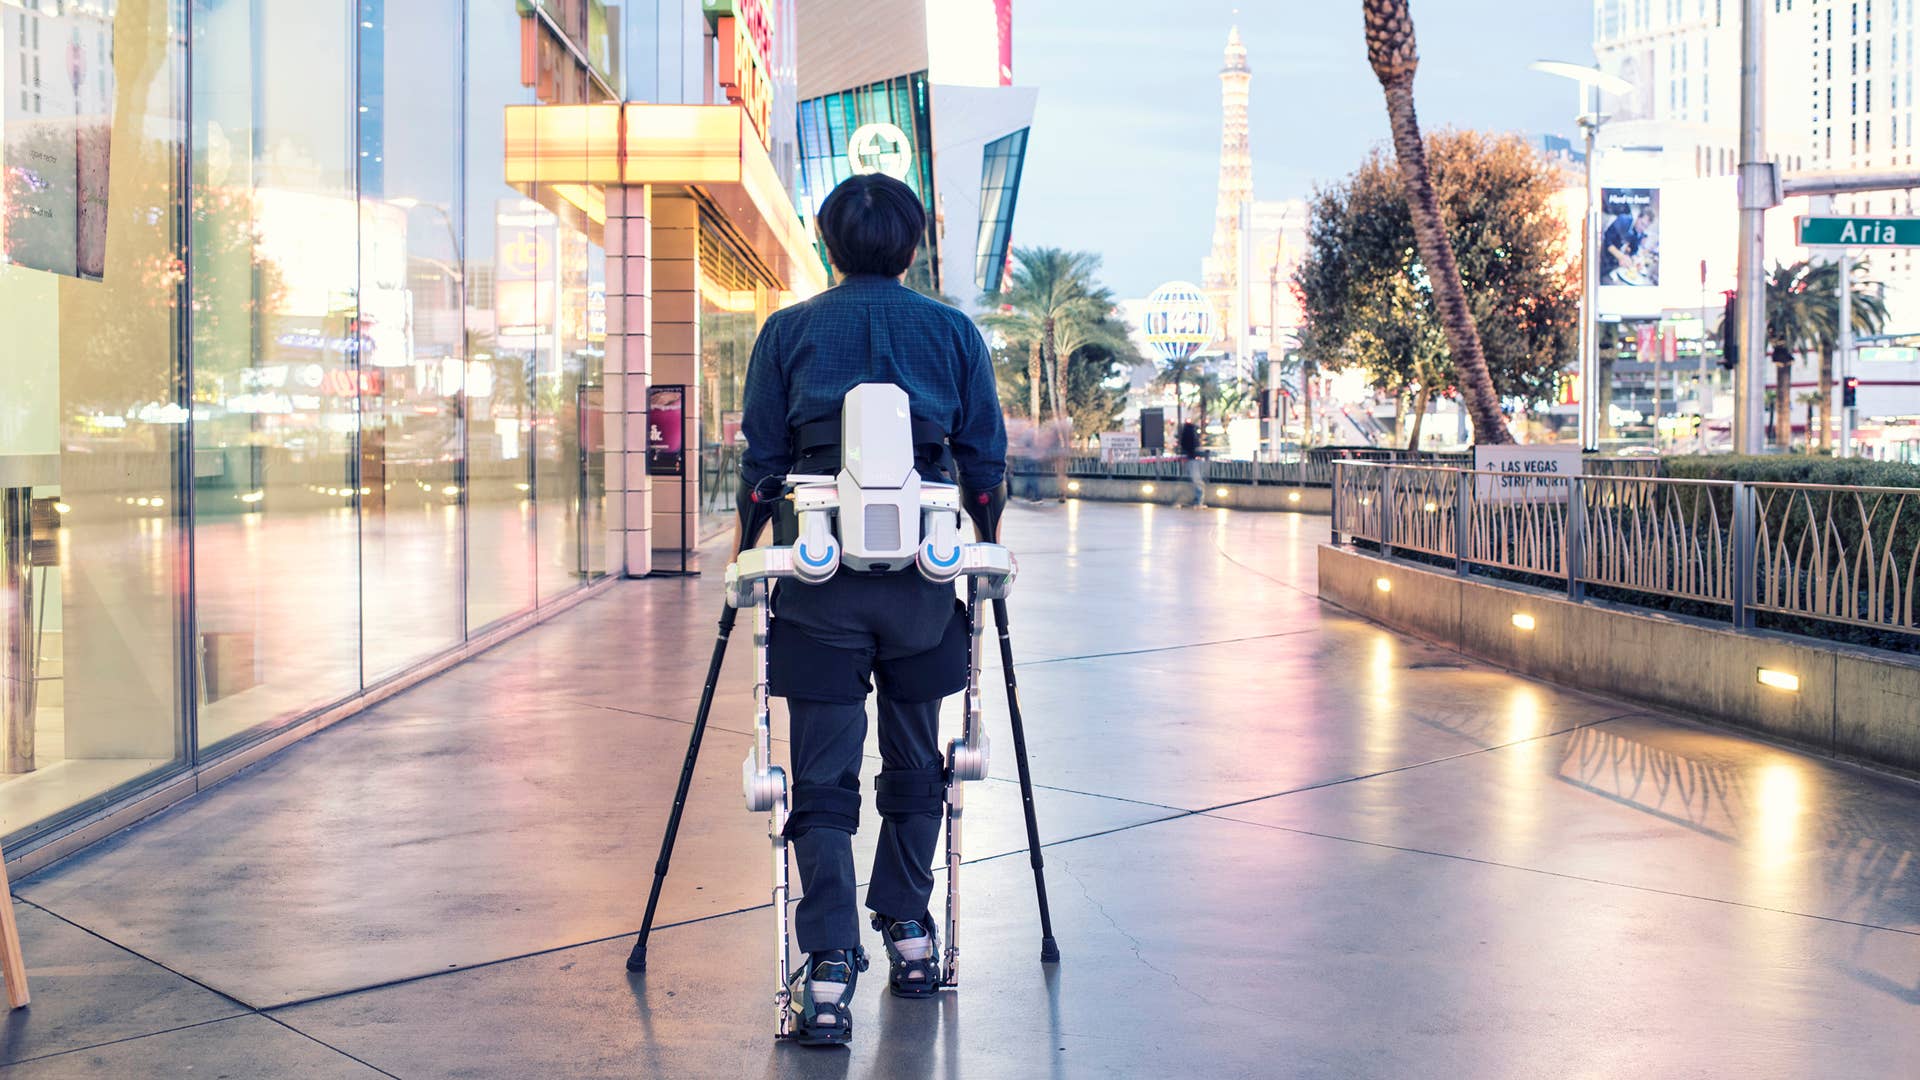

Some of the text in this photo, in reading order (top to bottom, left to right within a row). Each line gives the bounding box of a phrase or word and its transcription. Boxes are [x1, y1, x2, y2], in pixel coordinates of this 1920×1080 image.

[1840, 220, 1896, 243] Aria
[1501, 460, 1558, 473] LAS VEGAS
[1501, 475, 1531, 488] STRIP
